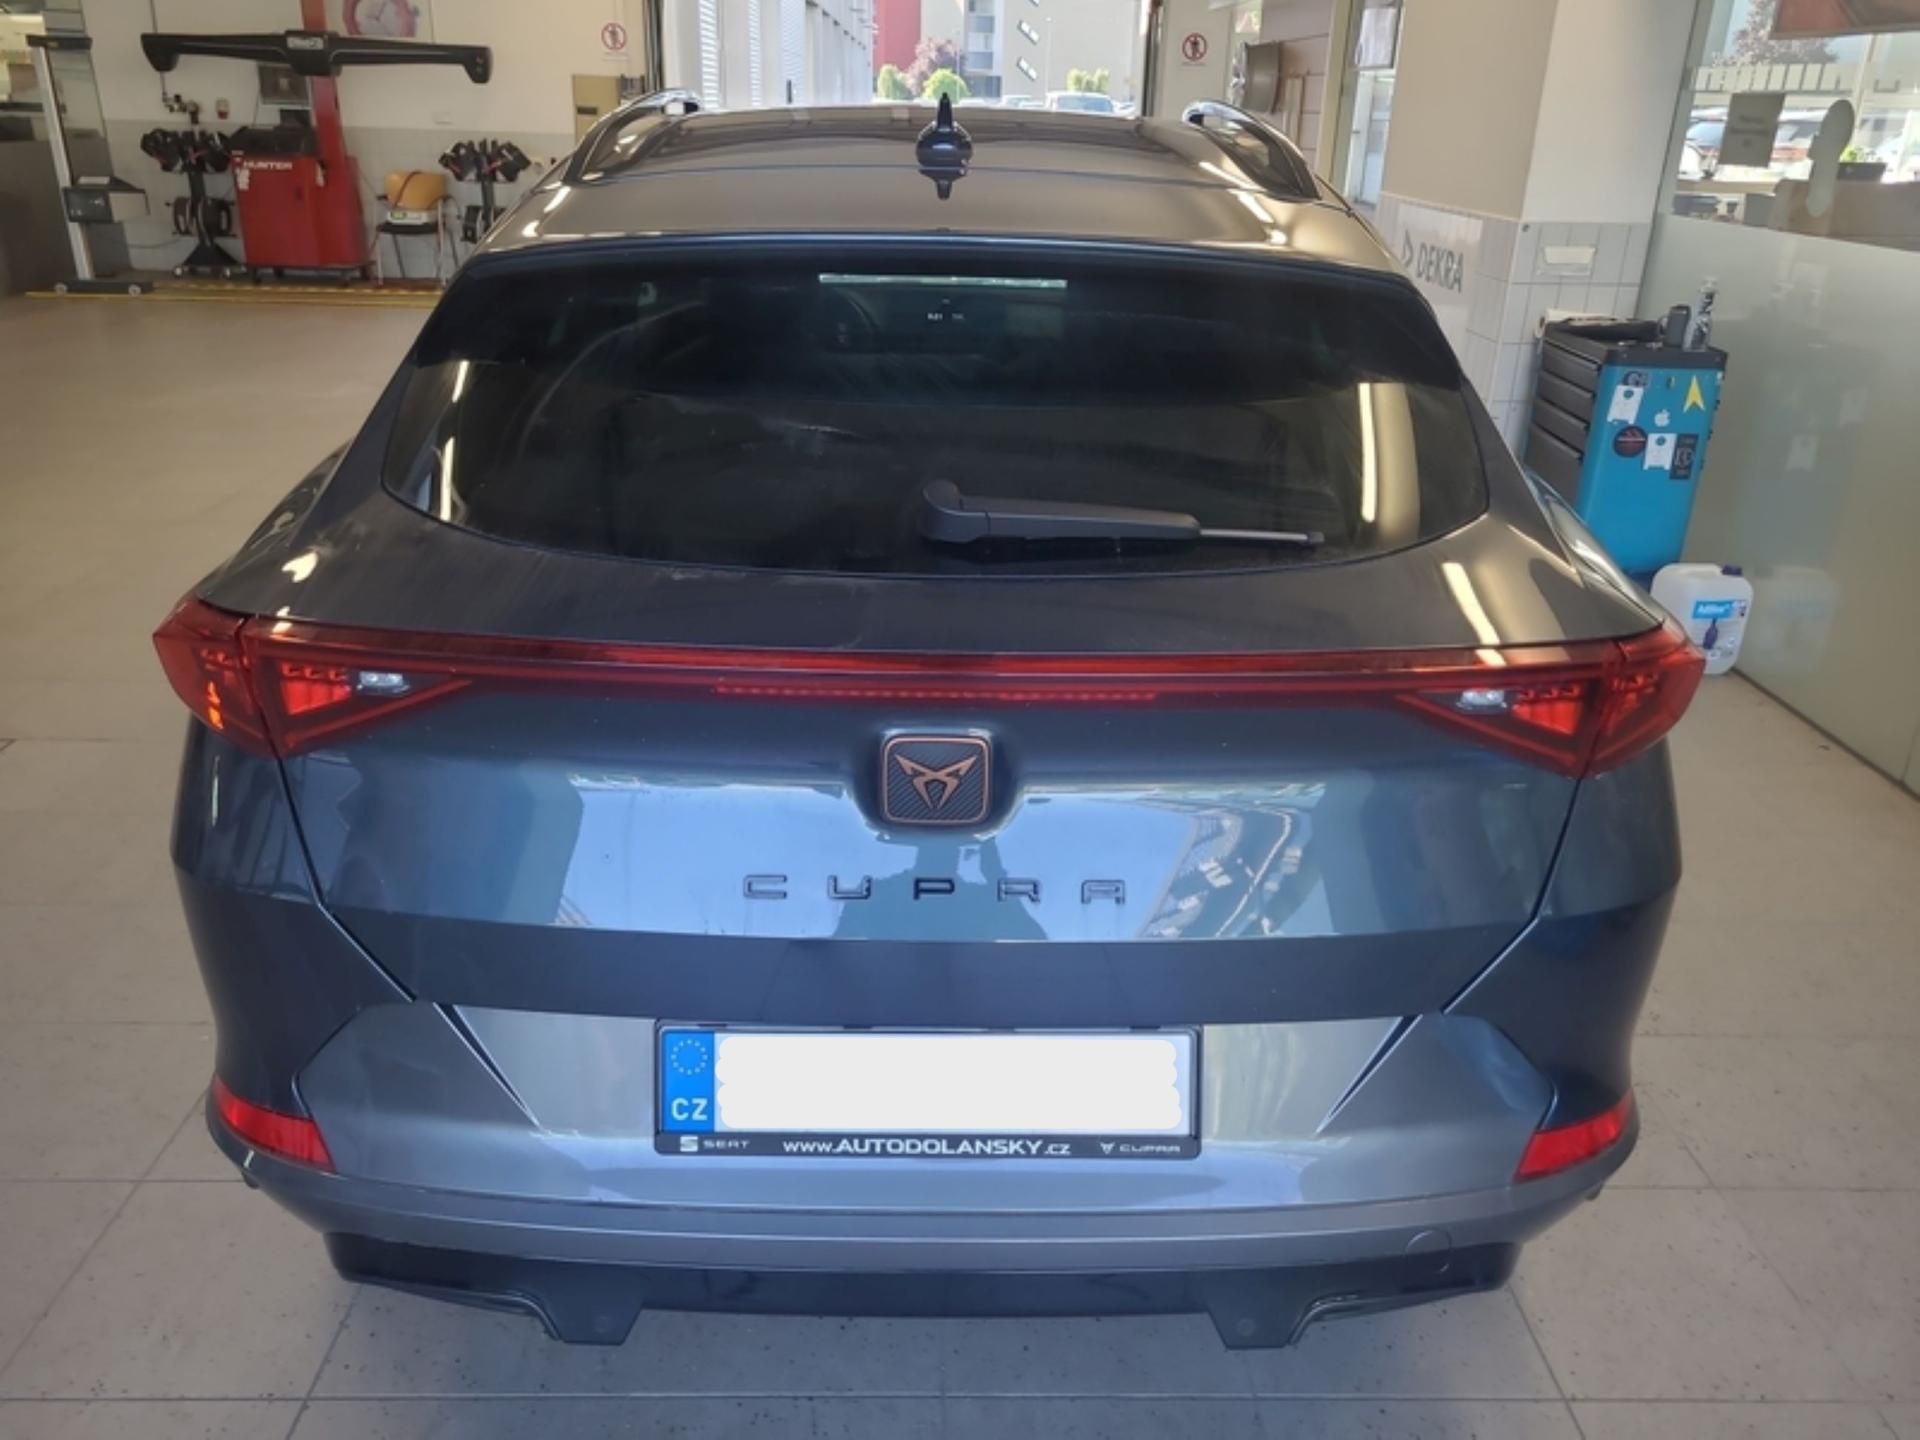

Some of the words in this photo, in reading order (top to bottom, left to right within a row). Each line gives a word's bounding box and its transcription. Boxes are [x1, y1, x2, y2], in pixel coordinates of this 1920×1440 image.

[1416, 242, 1464, 294] DEKRA
[742, 873, 1127, 907] CUPRA
[671, 1097, 708, 1121] CZ
[702, 1139, 750, 1150] SEAT
[782, 1138, 1071, 1156] www.AUTODOLANSKY.cz
